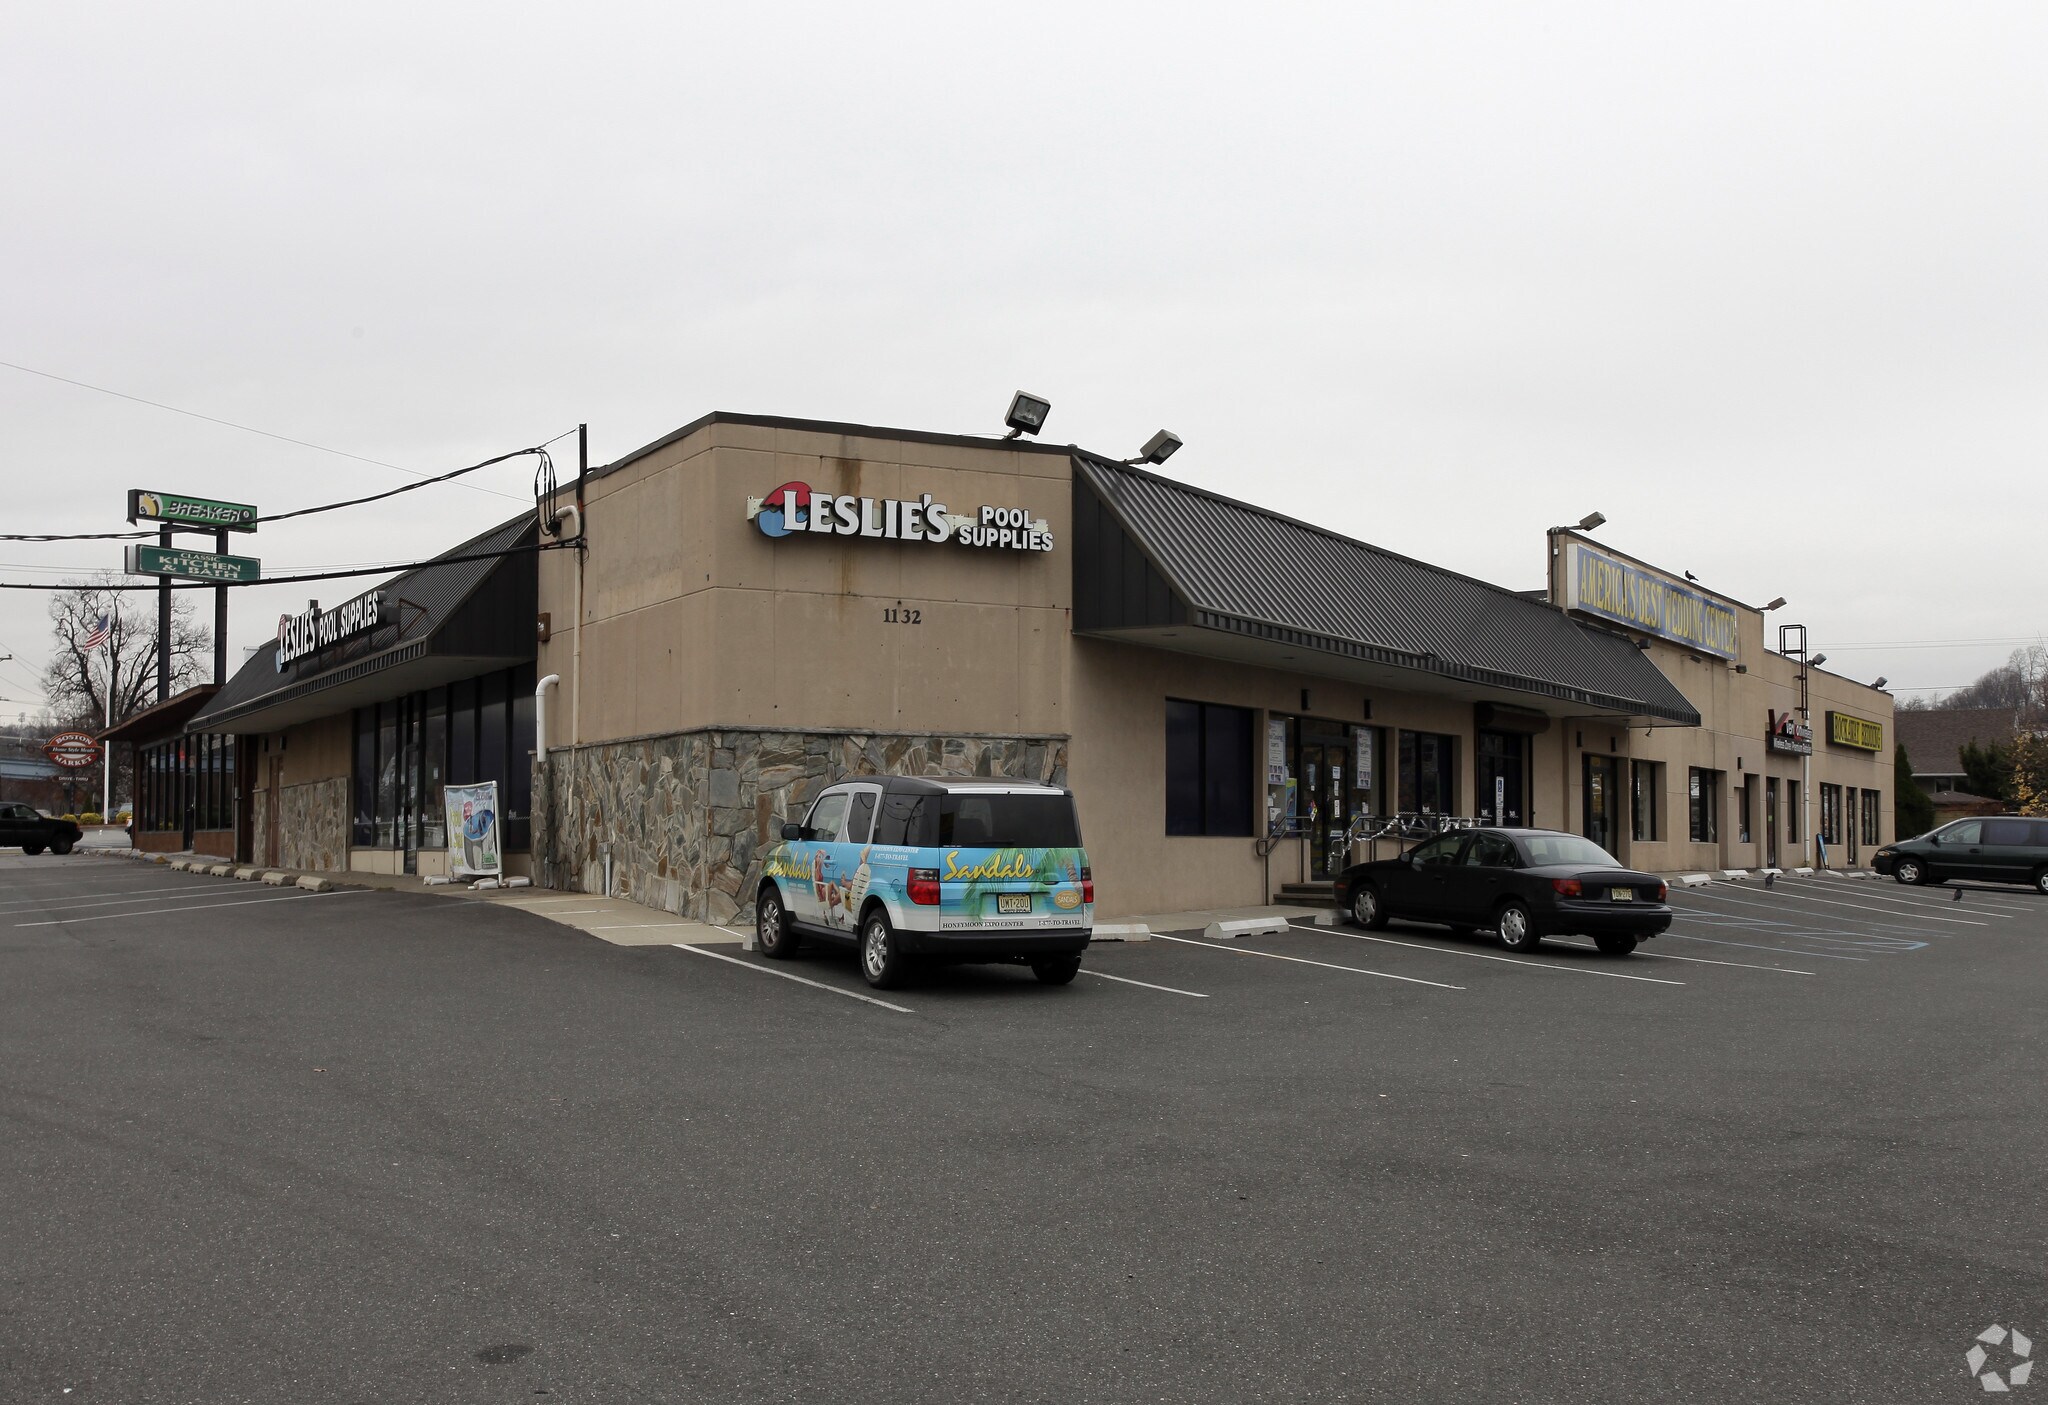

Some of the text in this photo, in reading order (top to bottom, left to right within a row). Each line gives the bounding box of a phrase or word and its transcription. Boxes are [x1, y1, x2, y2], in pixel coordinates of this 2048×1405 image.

[782, 490, 950, 543] LESLIE'S
[981, 505, 1034, 529] POOL
[958, 525, 1054, 552] SUPPLIES
[159, 556, 241, 572] KITCHEN
[180, 552, 220, 562] CLASSIC
[162, 564, 238, 579] & BATH
[1580, 555, 1736, 654] AMERICA'S BEST WEDDING CENTER
[319, 611, 338, 648] POOL
[340, 590, 379, 638] SUPPLIES
[883, 608, 922, 624] 1132
[55, 734, 93, 745] BOSTON
[54, 755, 92, 766] MARKET
[767, 845, 811, 880] Sandals
[943, 850, 1034, 882] Sandals
[1057, 895, 1078, 904] SANDALS
